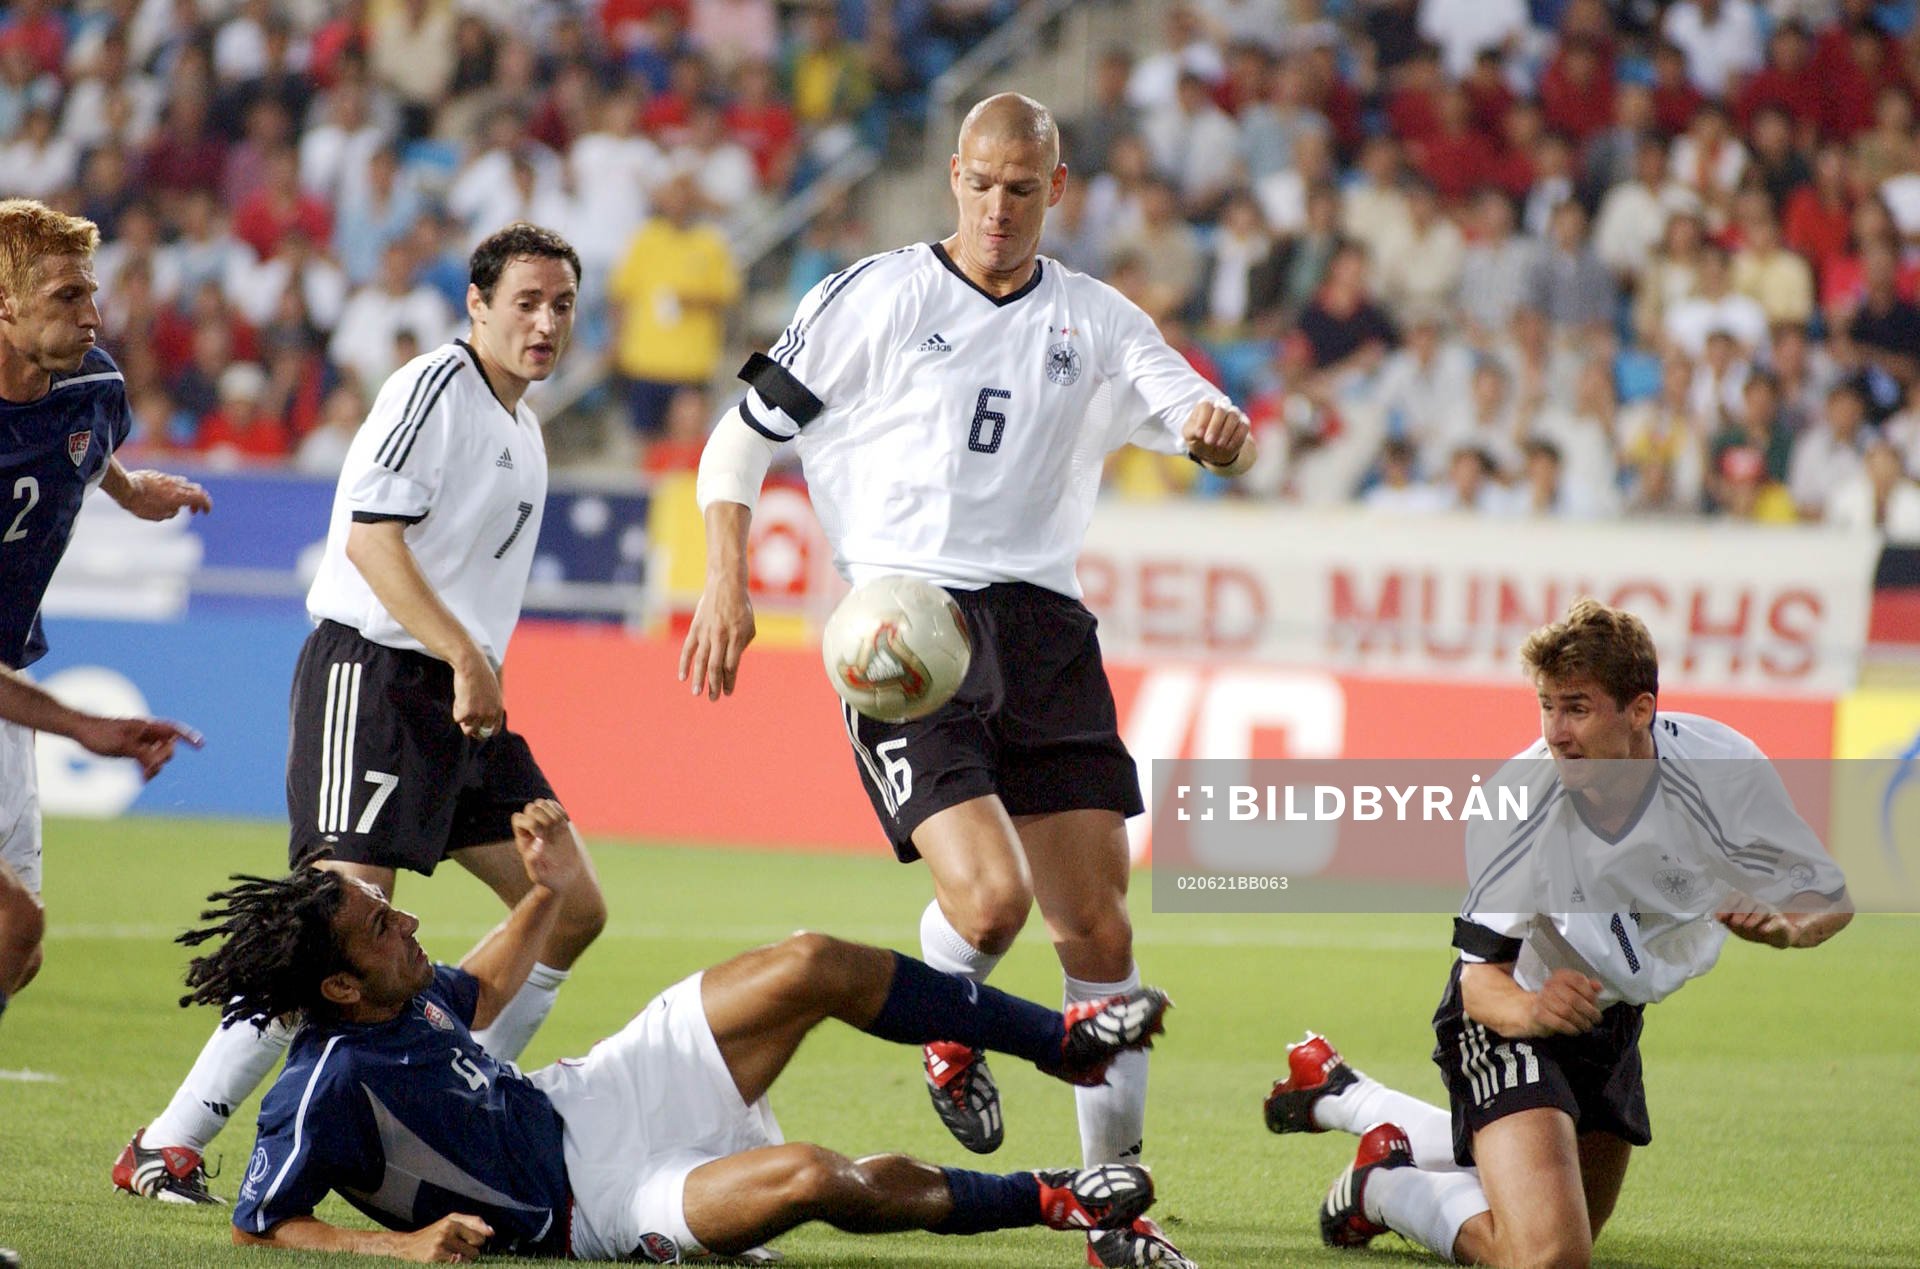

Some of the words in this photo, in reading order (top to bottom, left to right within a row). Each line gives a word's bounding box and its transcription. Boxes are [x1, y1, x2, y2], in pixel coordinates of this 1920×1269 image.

[968, 387, 1011, 454] 6
[2, 476, 39, 543] 2
[494, 501, 533, 559] 7
[1327, 566, 1823, 680] MUNHS
[355, 770, 400, 834] 7
[876, 737, 912, 807] 6
[451, 1047, 490, 1091] 4
[1494, 1043, 1540, 1089] 11
